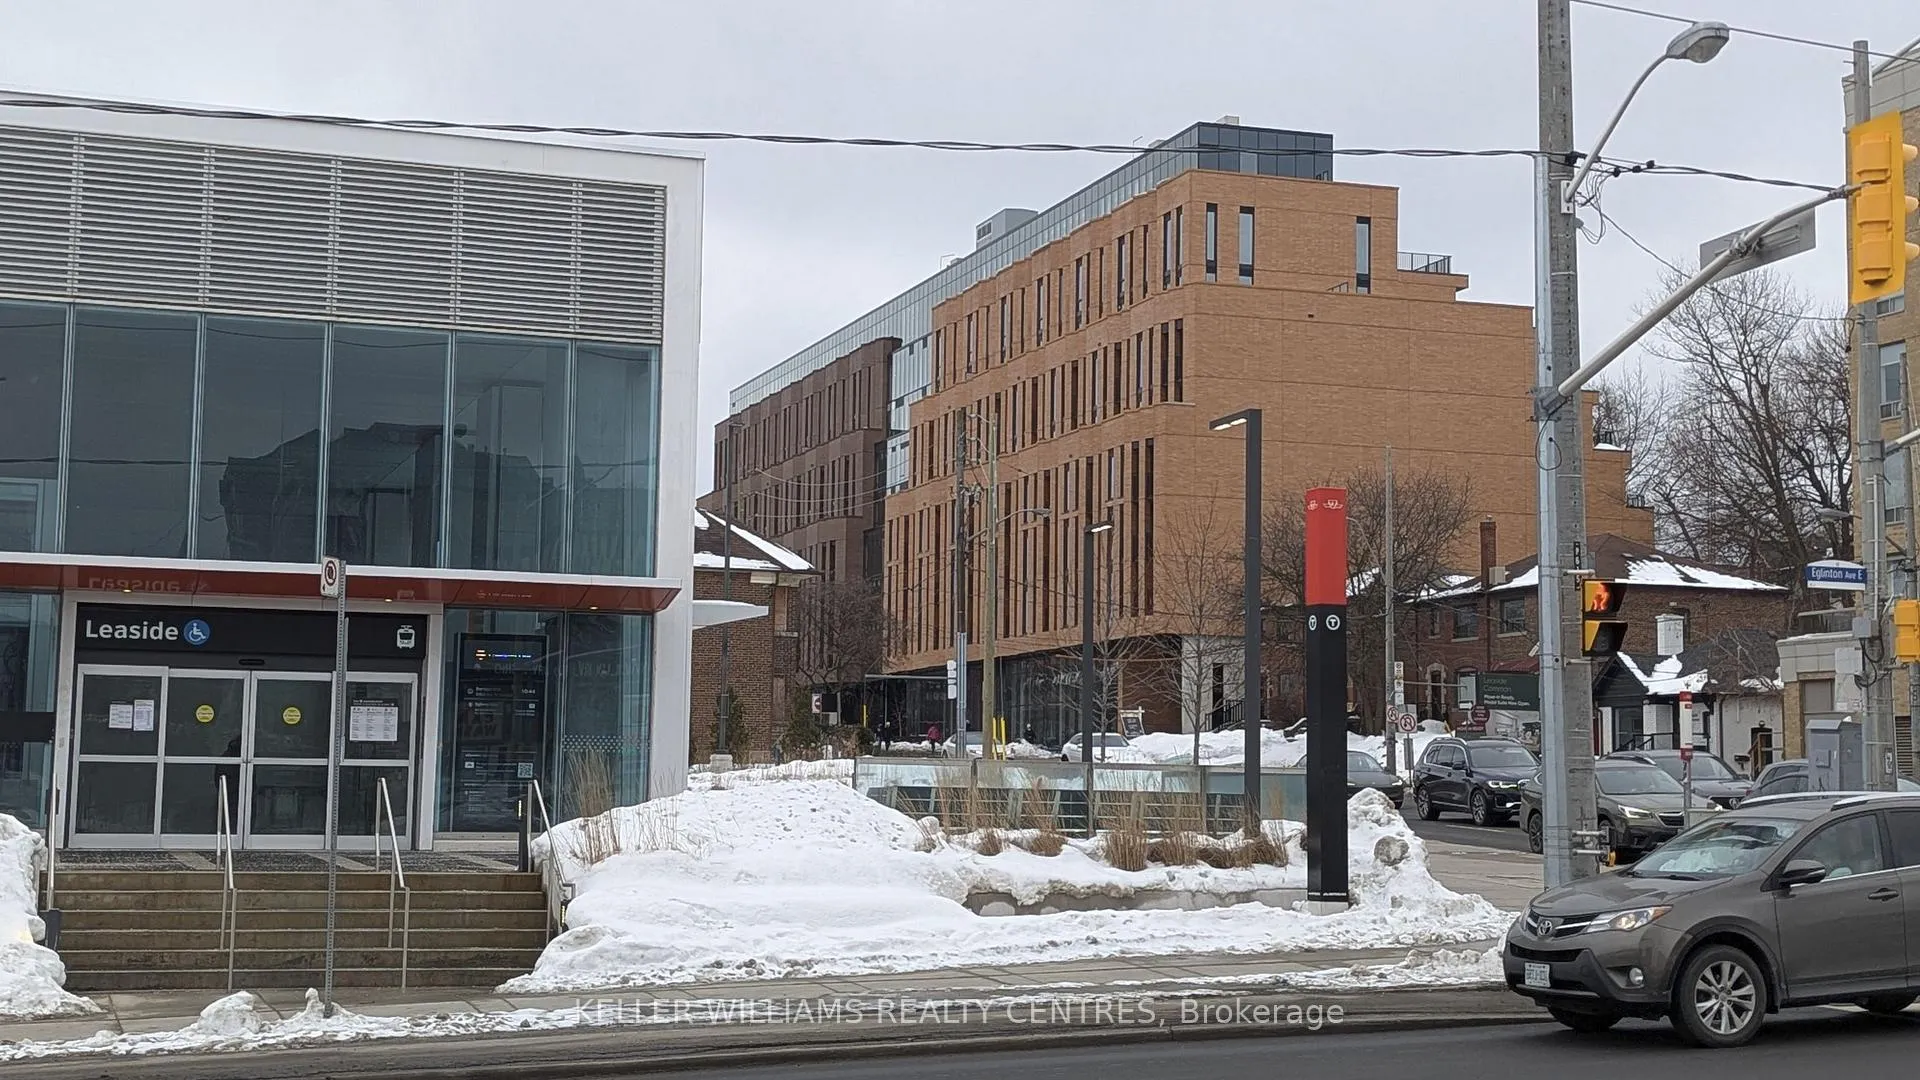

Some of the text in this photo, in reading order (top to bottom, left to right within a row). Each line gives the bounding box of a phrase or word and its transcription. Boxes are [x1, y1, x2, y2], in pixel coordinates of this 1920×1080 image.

[1811, 567, 1863, 580] Eglinton Ave E
[86, 619, 179, 641] Leaside
